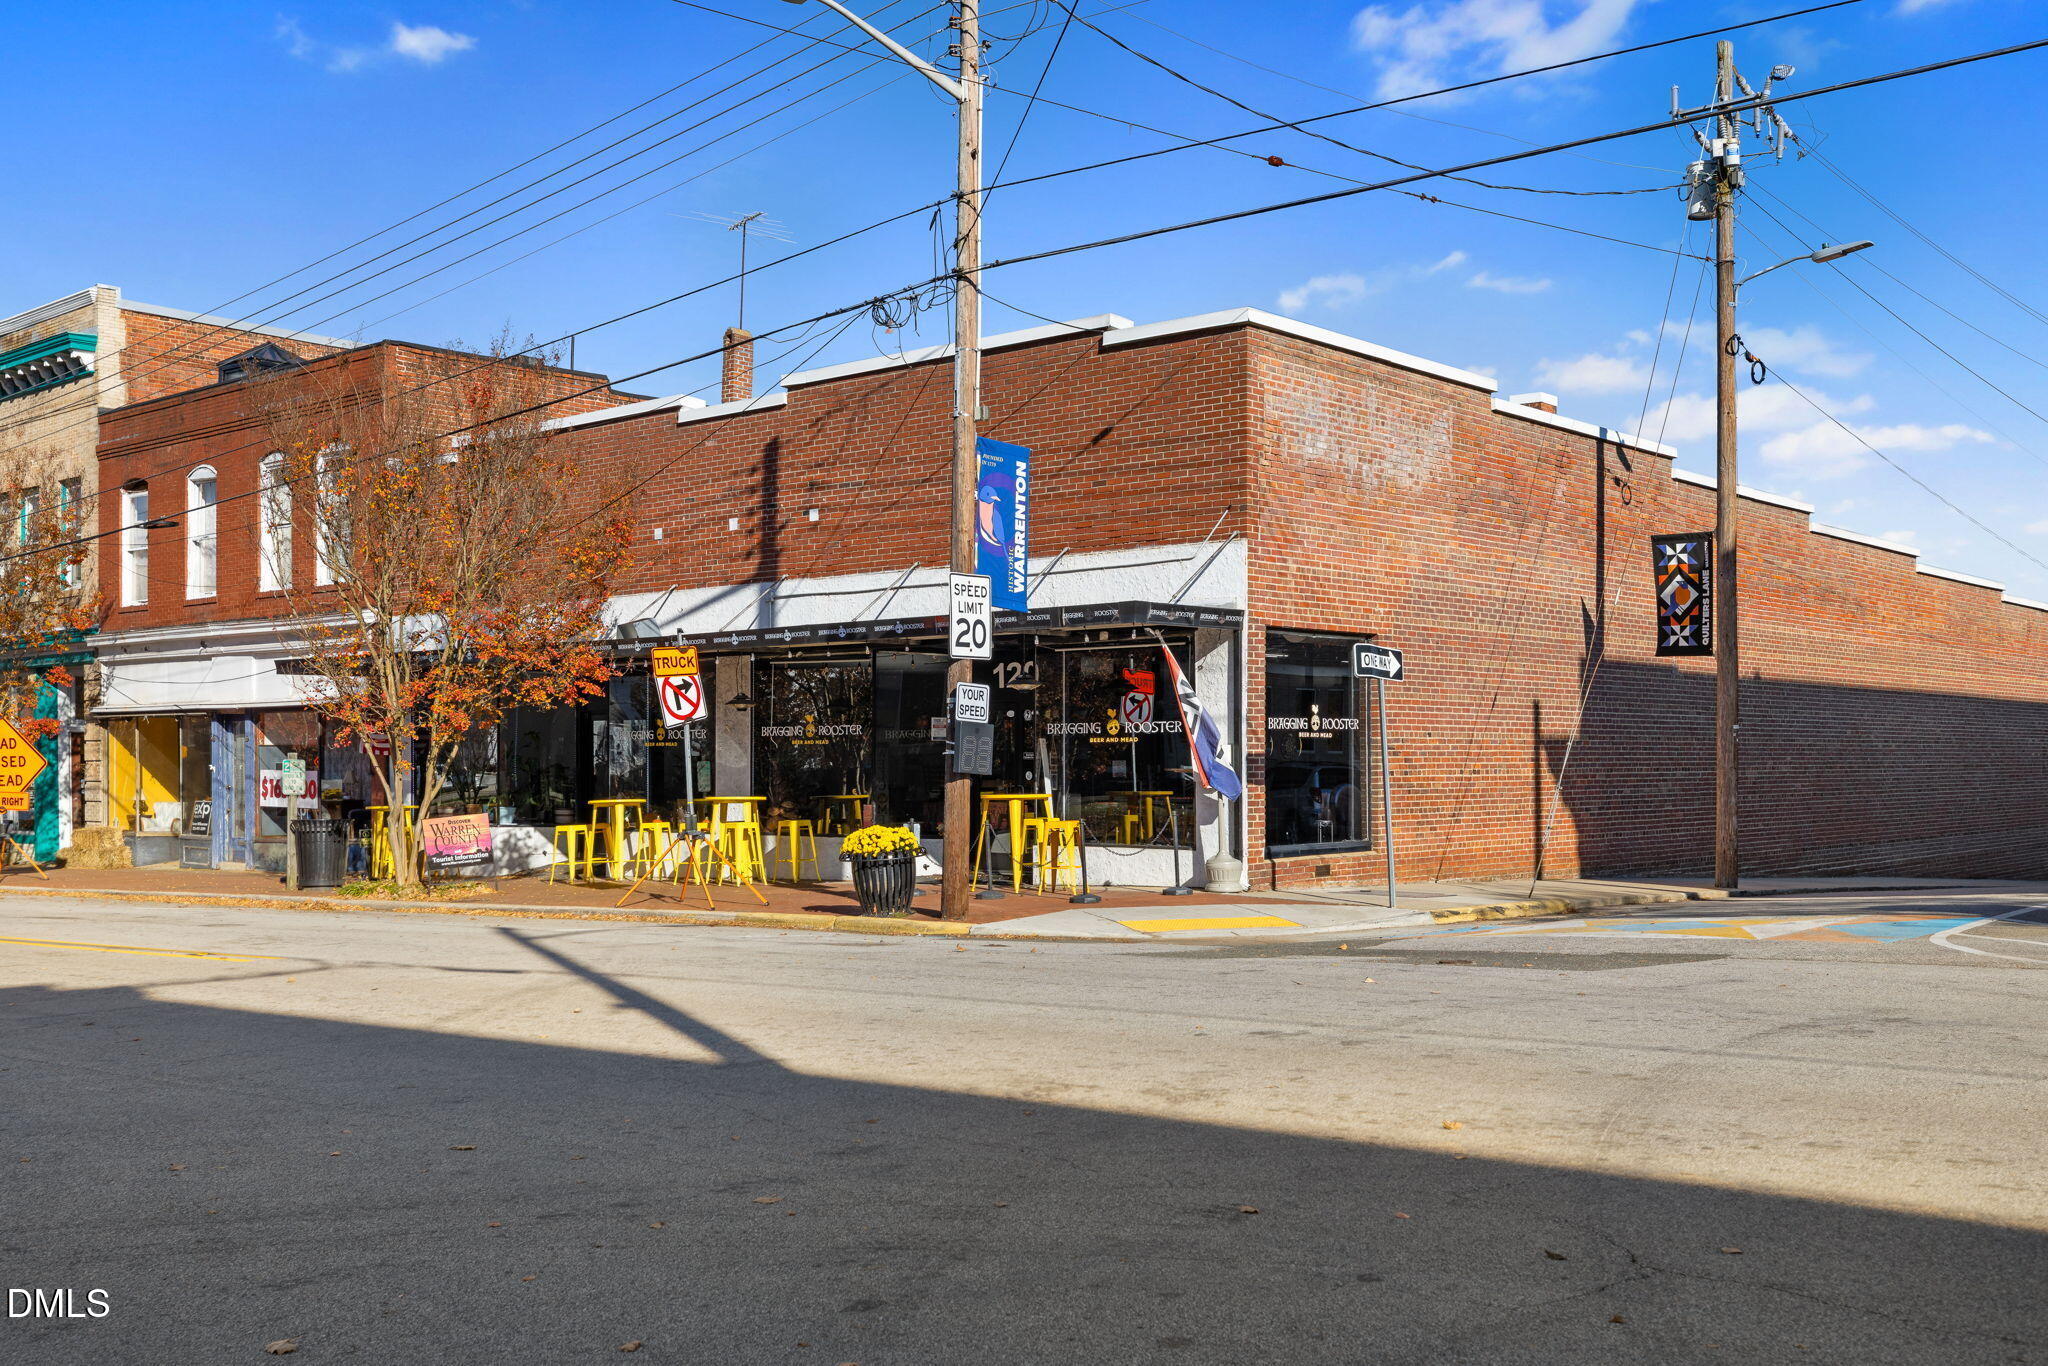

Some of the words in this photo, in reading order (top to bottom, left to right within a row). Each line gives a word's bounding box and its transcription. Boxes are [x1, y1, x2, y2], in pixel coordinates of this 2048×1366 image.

[1014, 460, 1027, 594] WARRENTON
[954, 584, 988, 598] SPEED
[958, 601, 984, 614] LIMIT
[955, 618, 986, 648] 20
[655, 656, 695, 668] TRUCK
[1364, 654, 1378, 668] ONE
[1379, 656, 1391, 670] WAY
[962, 688, 984, 701] YOUR
[959, 704, 986, 718] SPEED
[762, 726, 803, 736] BRAGGING
[818, 725, 862, 735] ROOSTER
[1048, 722, 1101, 734] BRAGGING
[1125, 721, 1182, 733] ROOSTER
[1268, 718, 1308, 729] BRAGGING
[1322, 718, 1359, 730] ROOSTER
[2, 797, 24, 806] RIGHT
[430, 823, 481, 836] WARREN
[435, 834, 480, 852] COUNTY
[455, 852, 488, 860] Information
